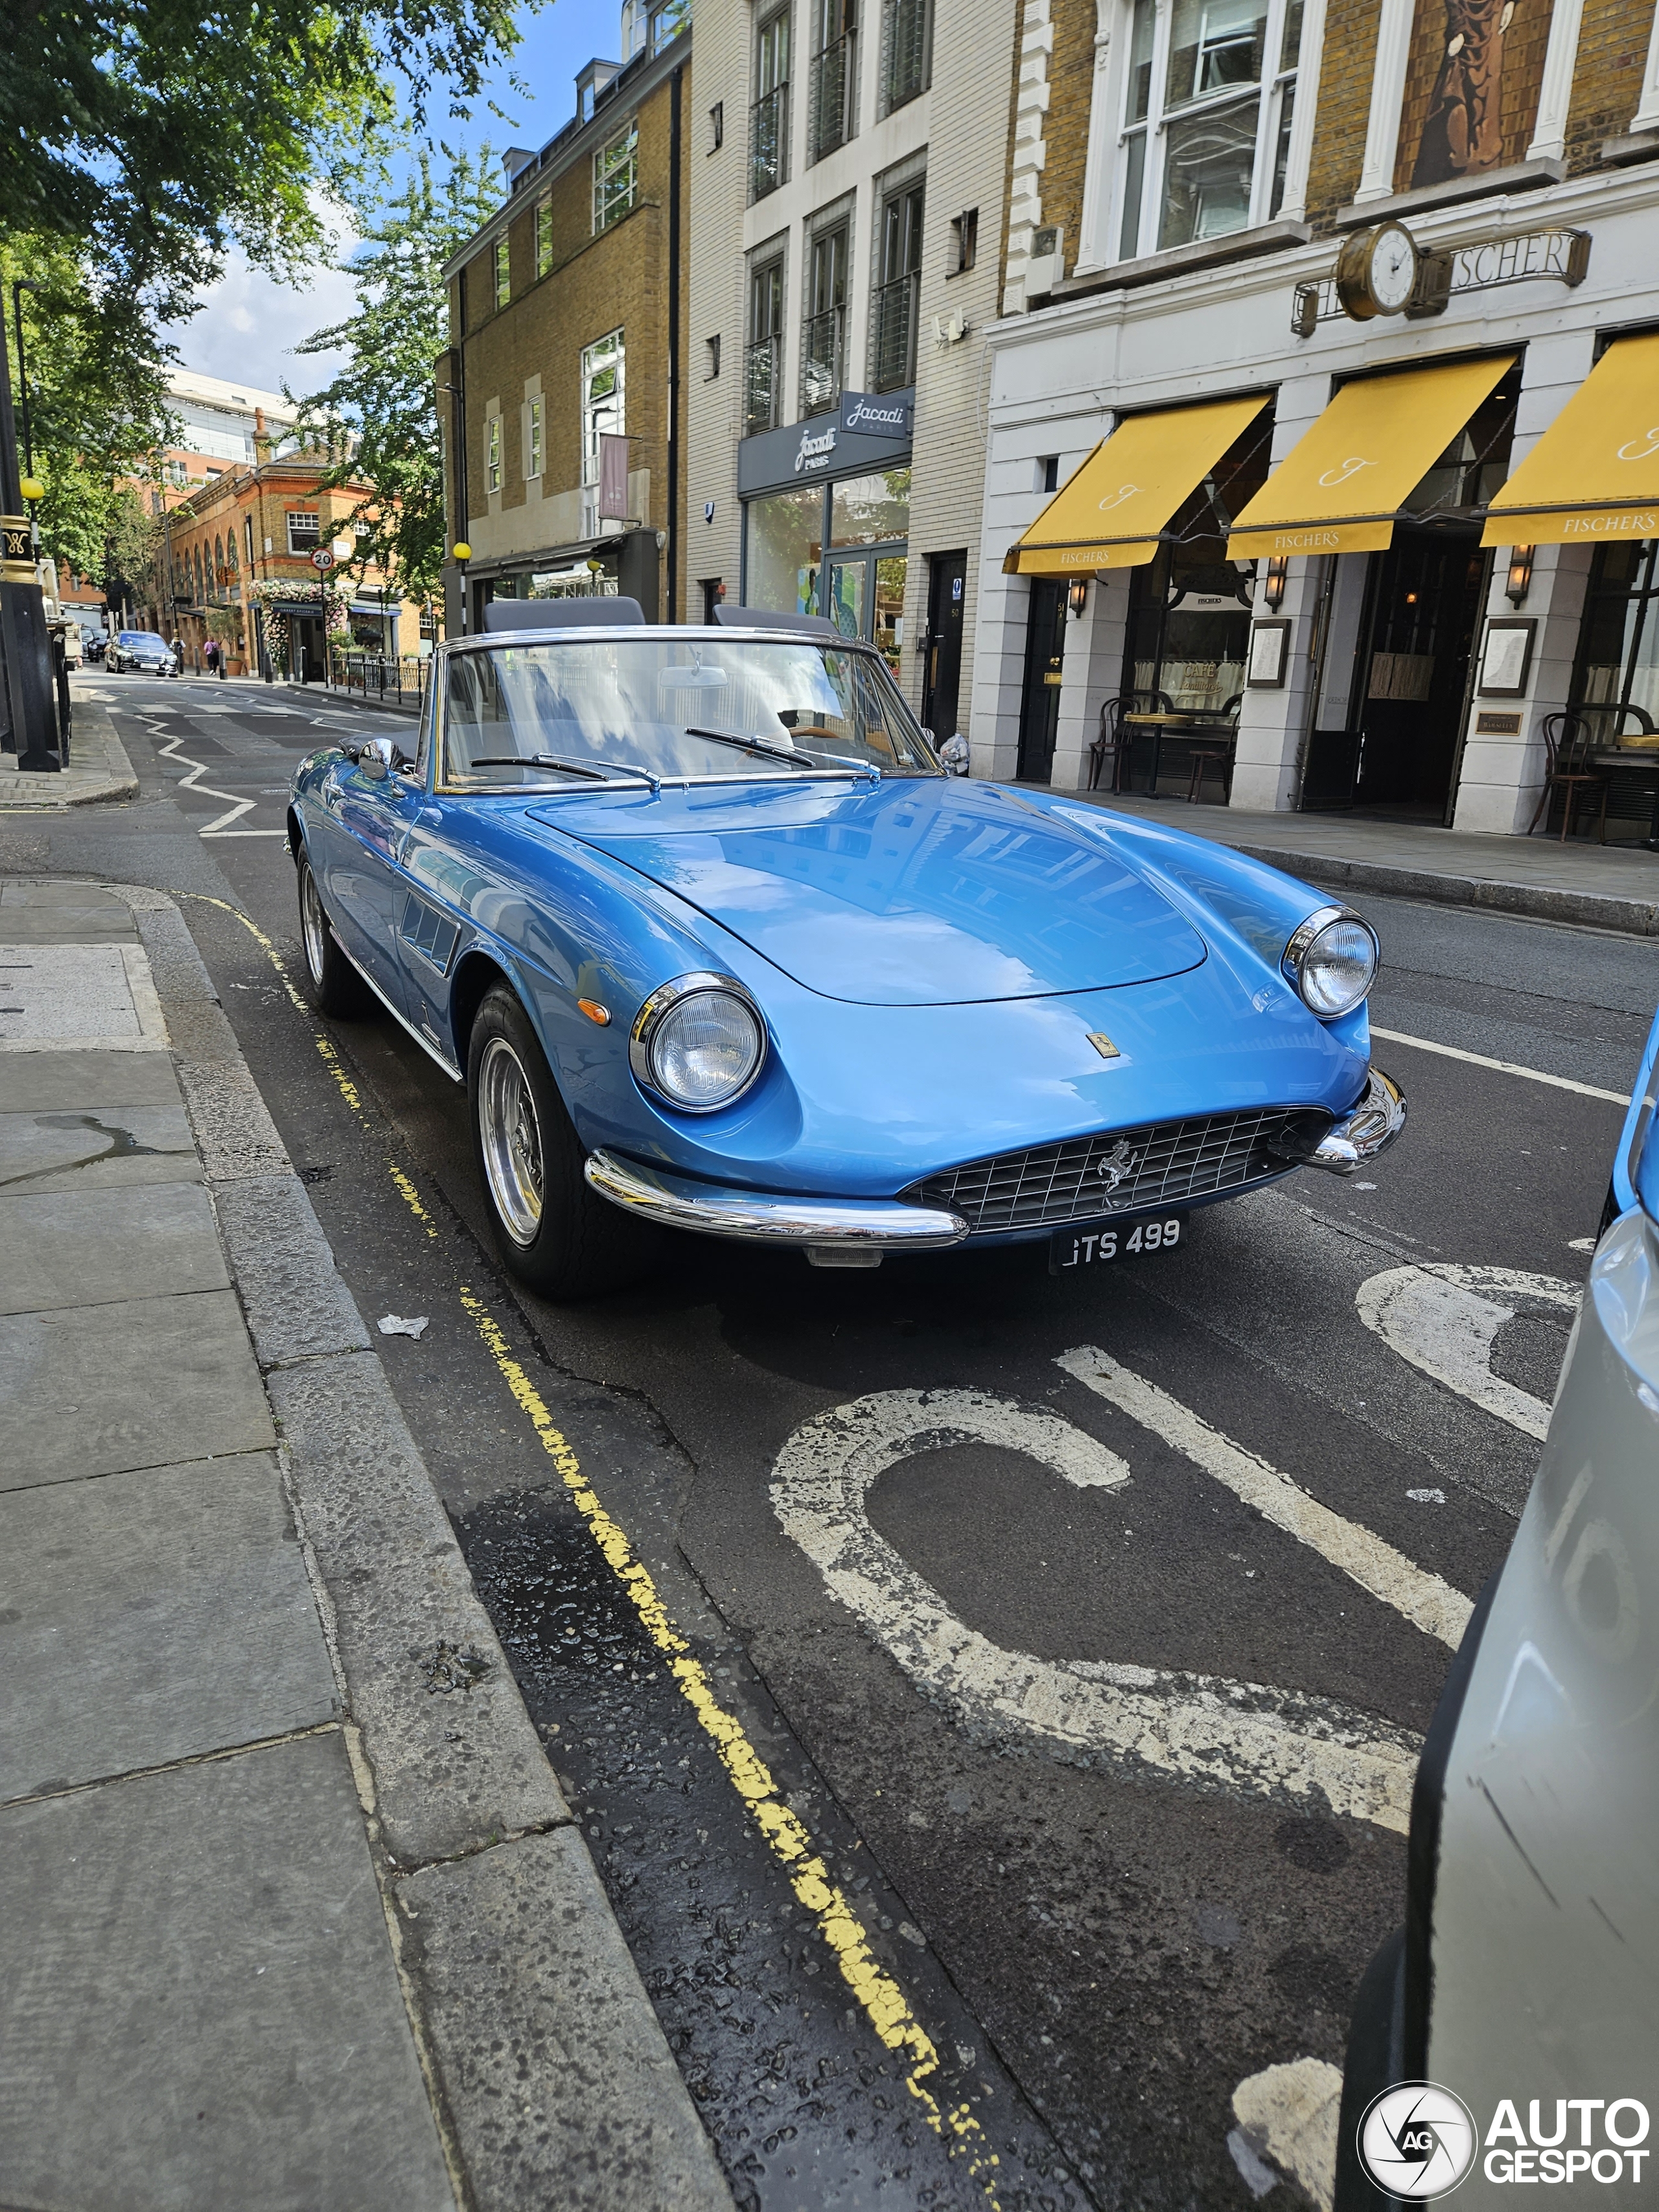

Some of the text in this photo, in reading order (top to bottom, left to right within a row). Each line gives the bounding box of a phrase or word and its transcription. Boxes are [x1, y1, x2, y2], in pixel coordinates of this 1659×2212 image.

[846, 399, 903, 427] jacadi
[863, 423, 893, 432] PARIS
[795, 428, 837, 472] jacadi
[805, 455, 830, 471] PARIS
[314, 554, 331, 565] 20
[1183, 661, 1216, 678] CAFÉ
[1126, 1219, 1180, 1253] 499
